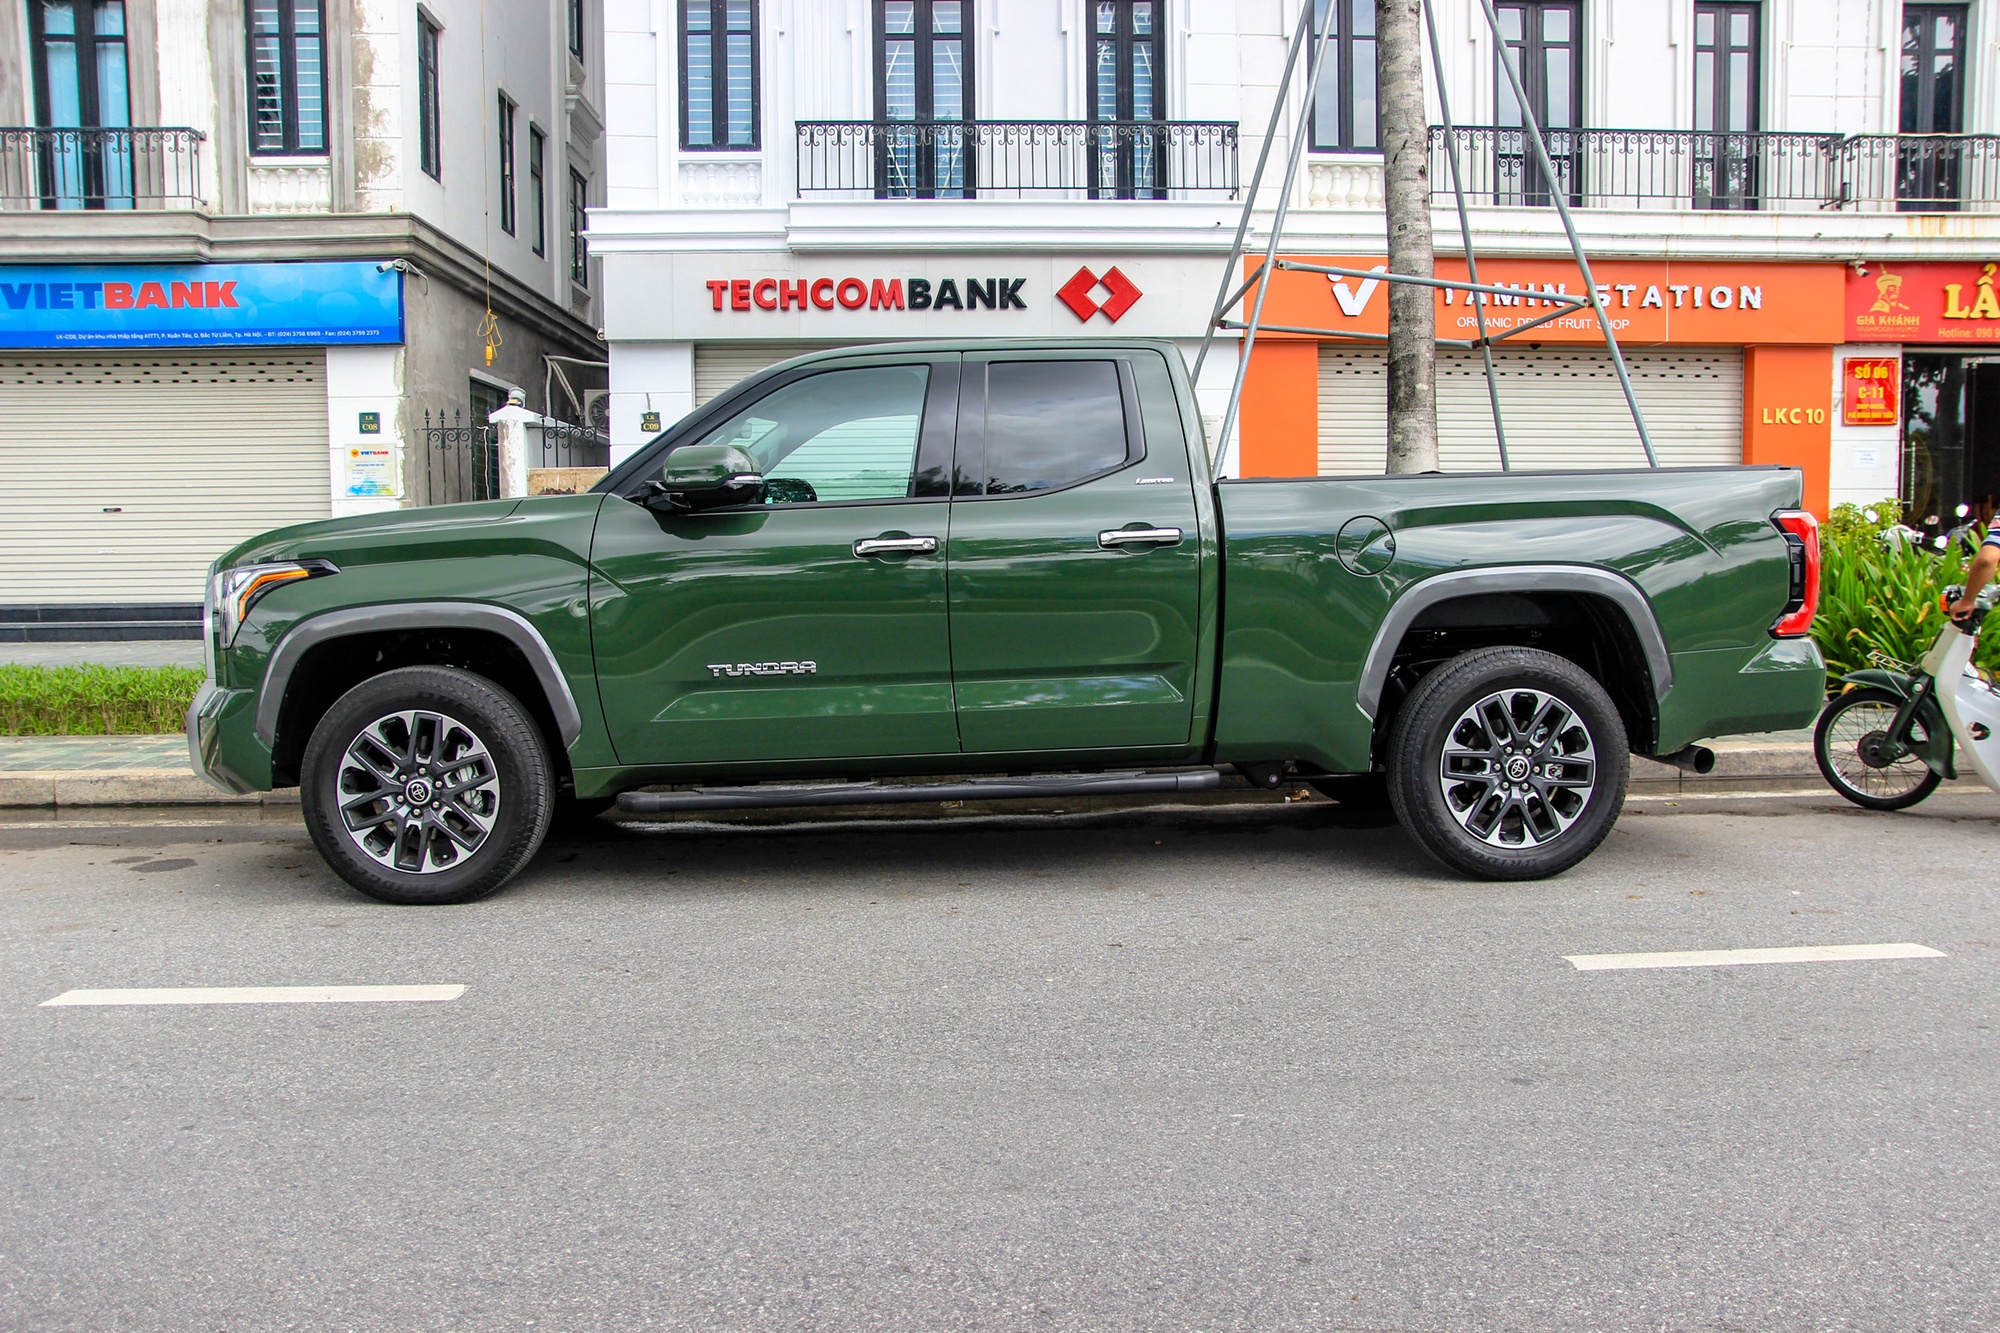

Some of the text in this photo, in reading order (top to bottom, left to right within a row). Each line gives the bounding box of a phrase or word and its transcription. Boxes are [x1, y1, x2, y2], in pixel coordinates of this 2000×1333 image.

[0, 281, 240, 310] VIETBANK
[705, 277, 1028, 311] TECHCOMBANK
[1594, 283, 1763, 310] STATION
[1943, 262, 2000, 319] LẨ
[1558, 318, 1592, 329] FRUIT
[1856, 313, 1920, 326] GIA KHÁNH
[1938, 327, 1974, 338] Hotline:
[1976, 327, 1993, 338] 090
[1854, 362, 1889, 379] SỐ 06
[1858, 386, 1884, 399] C-11
[1762, 407, 1825, 424] LKC 10
[706, 660, 817, 677] TUNDRA
